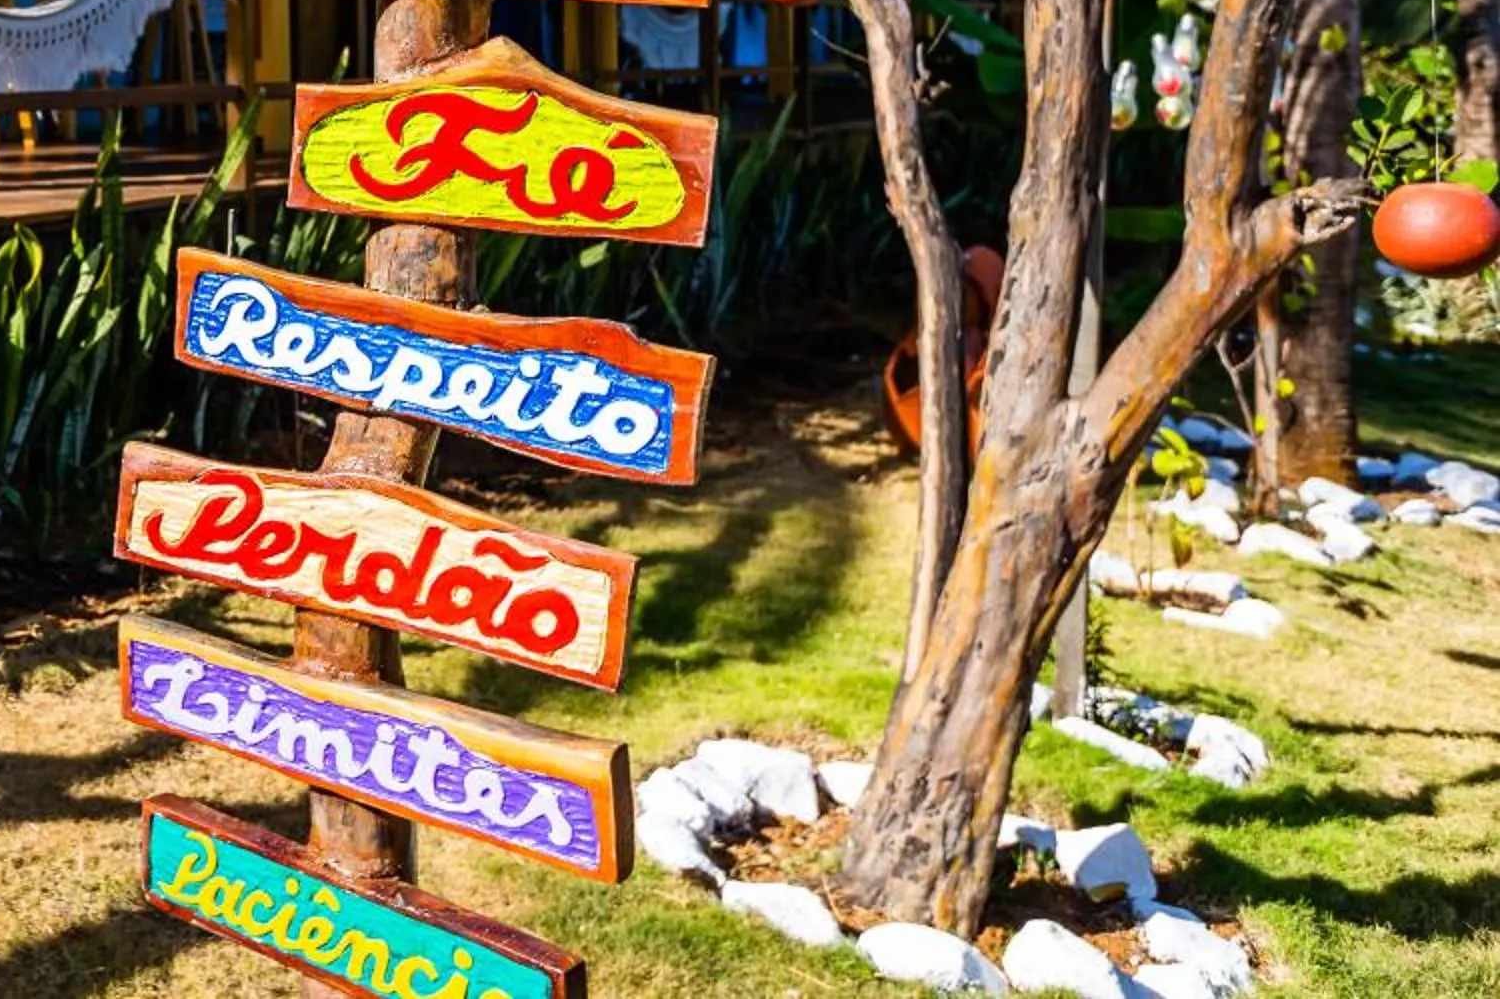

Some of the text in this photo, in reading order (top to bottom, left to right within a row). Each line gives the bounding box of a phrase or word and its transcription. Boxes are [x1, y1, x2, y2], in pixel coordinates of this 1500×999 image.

[352, 93, 637, 220] Fé
[200, 279, 659, 454] Respeito
[146, 471, 580, 654] Perdão
[144, 659, 573, 846] Limites
[158, 833, 513, 999] Paciênci
